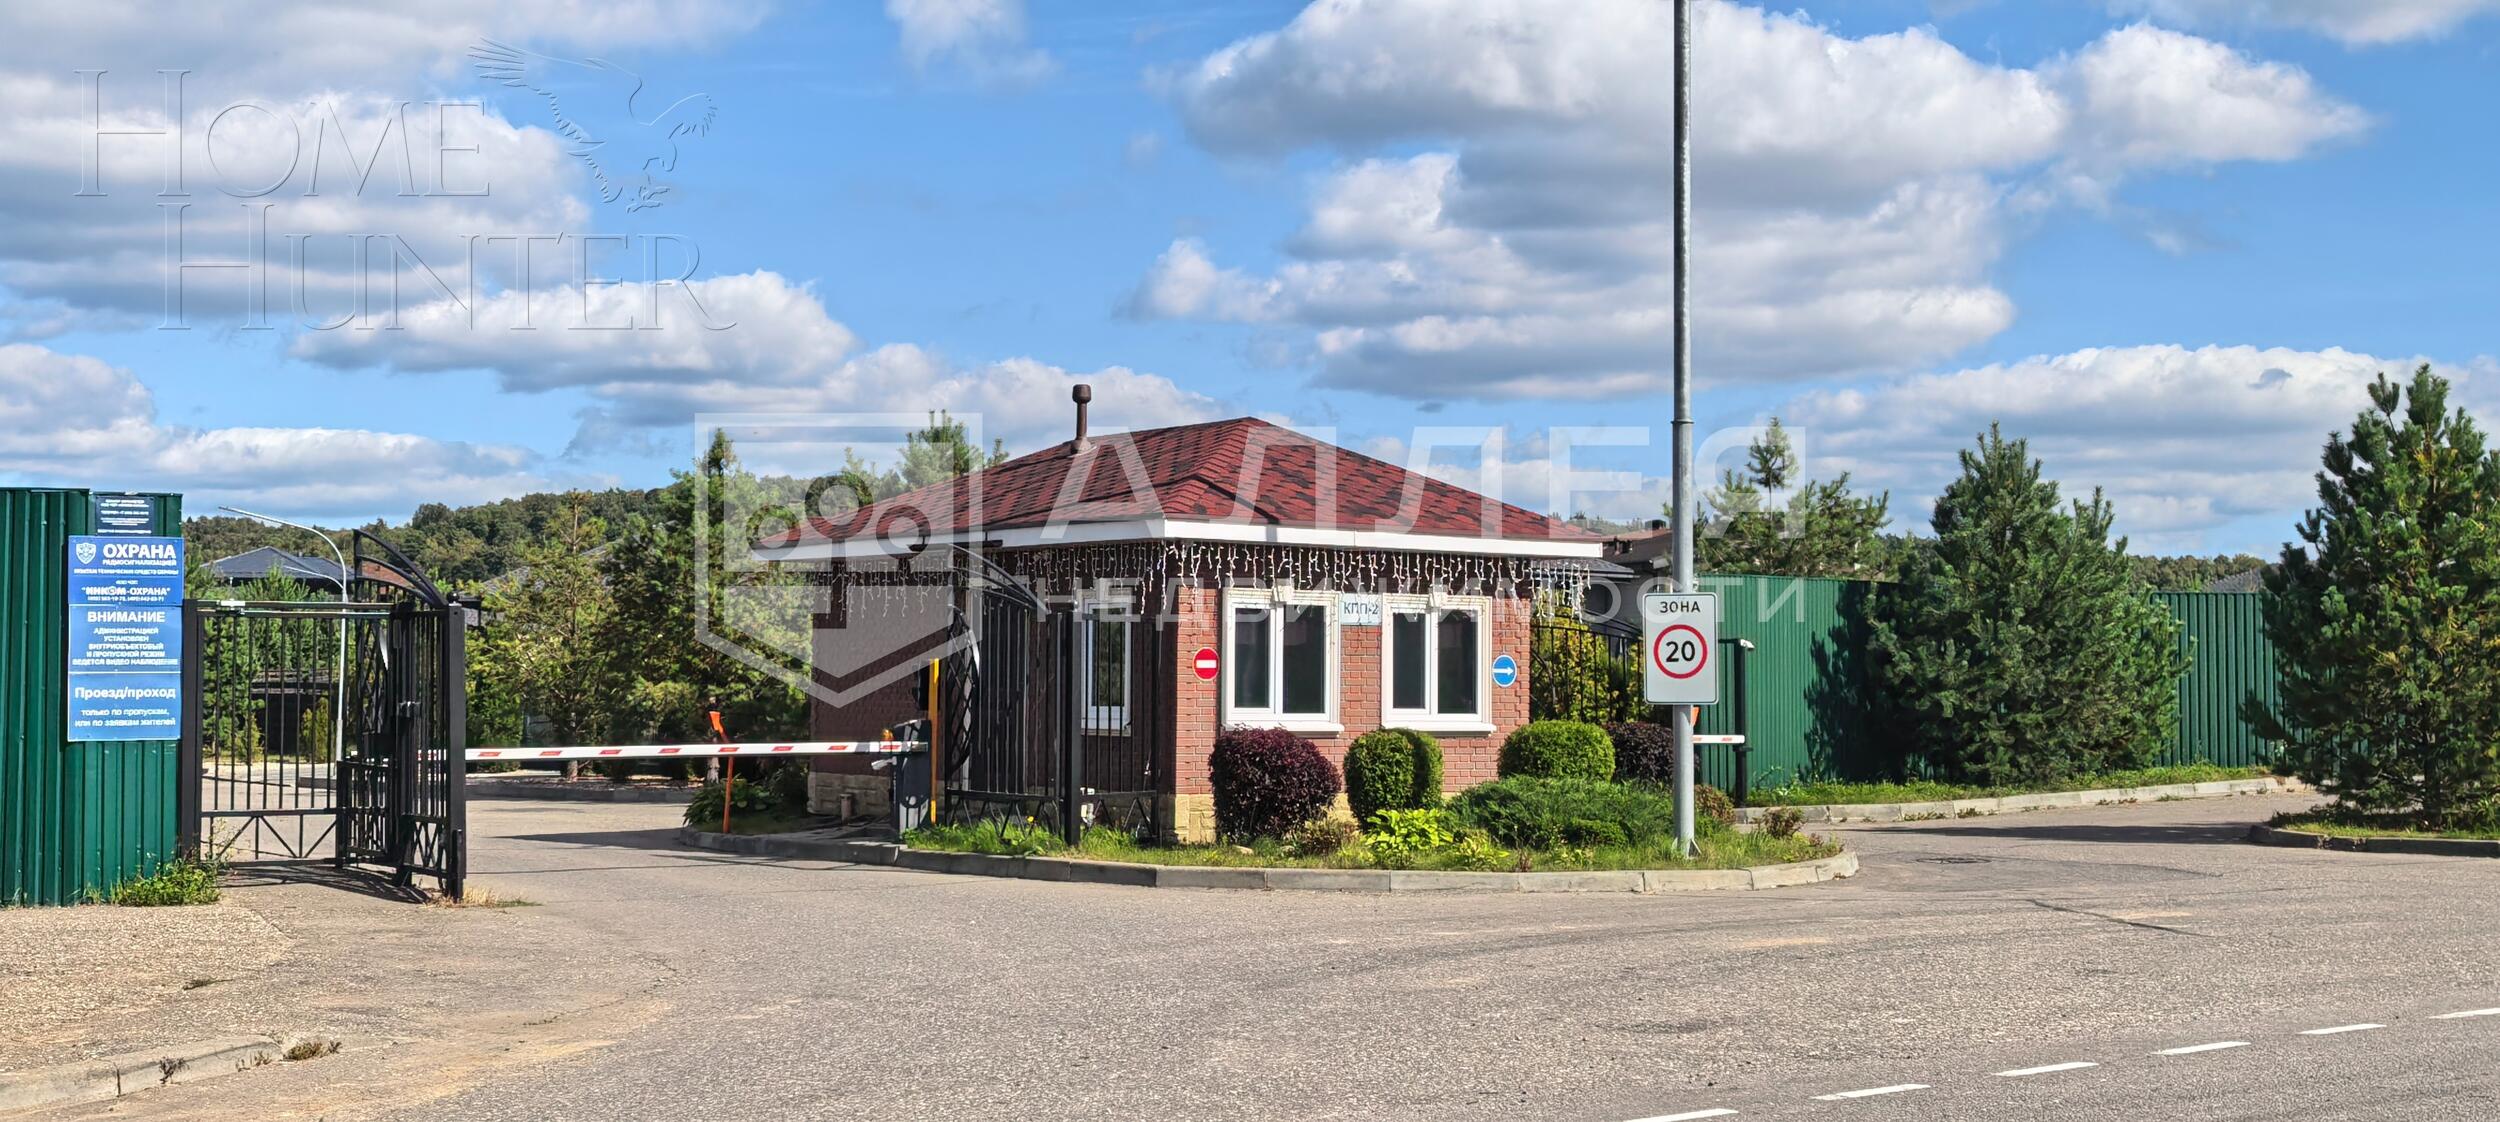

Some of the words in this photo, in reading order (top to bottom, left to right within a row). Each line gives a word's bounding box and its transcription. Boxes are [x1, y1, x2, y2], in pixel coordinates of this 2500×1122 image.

[102, 543, 177, 559] ОХРАНА
[1344, 602, 1379, 615] КПП-2
[1660, 601, 1701, 613] ЗОНА
[87, 611, 166, 623] ВНИМАНИЕ
[1666, 641, 1695, 662] 20
[75, 686, 176, 700] Проезд/проход
